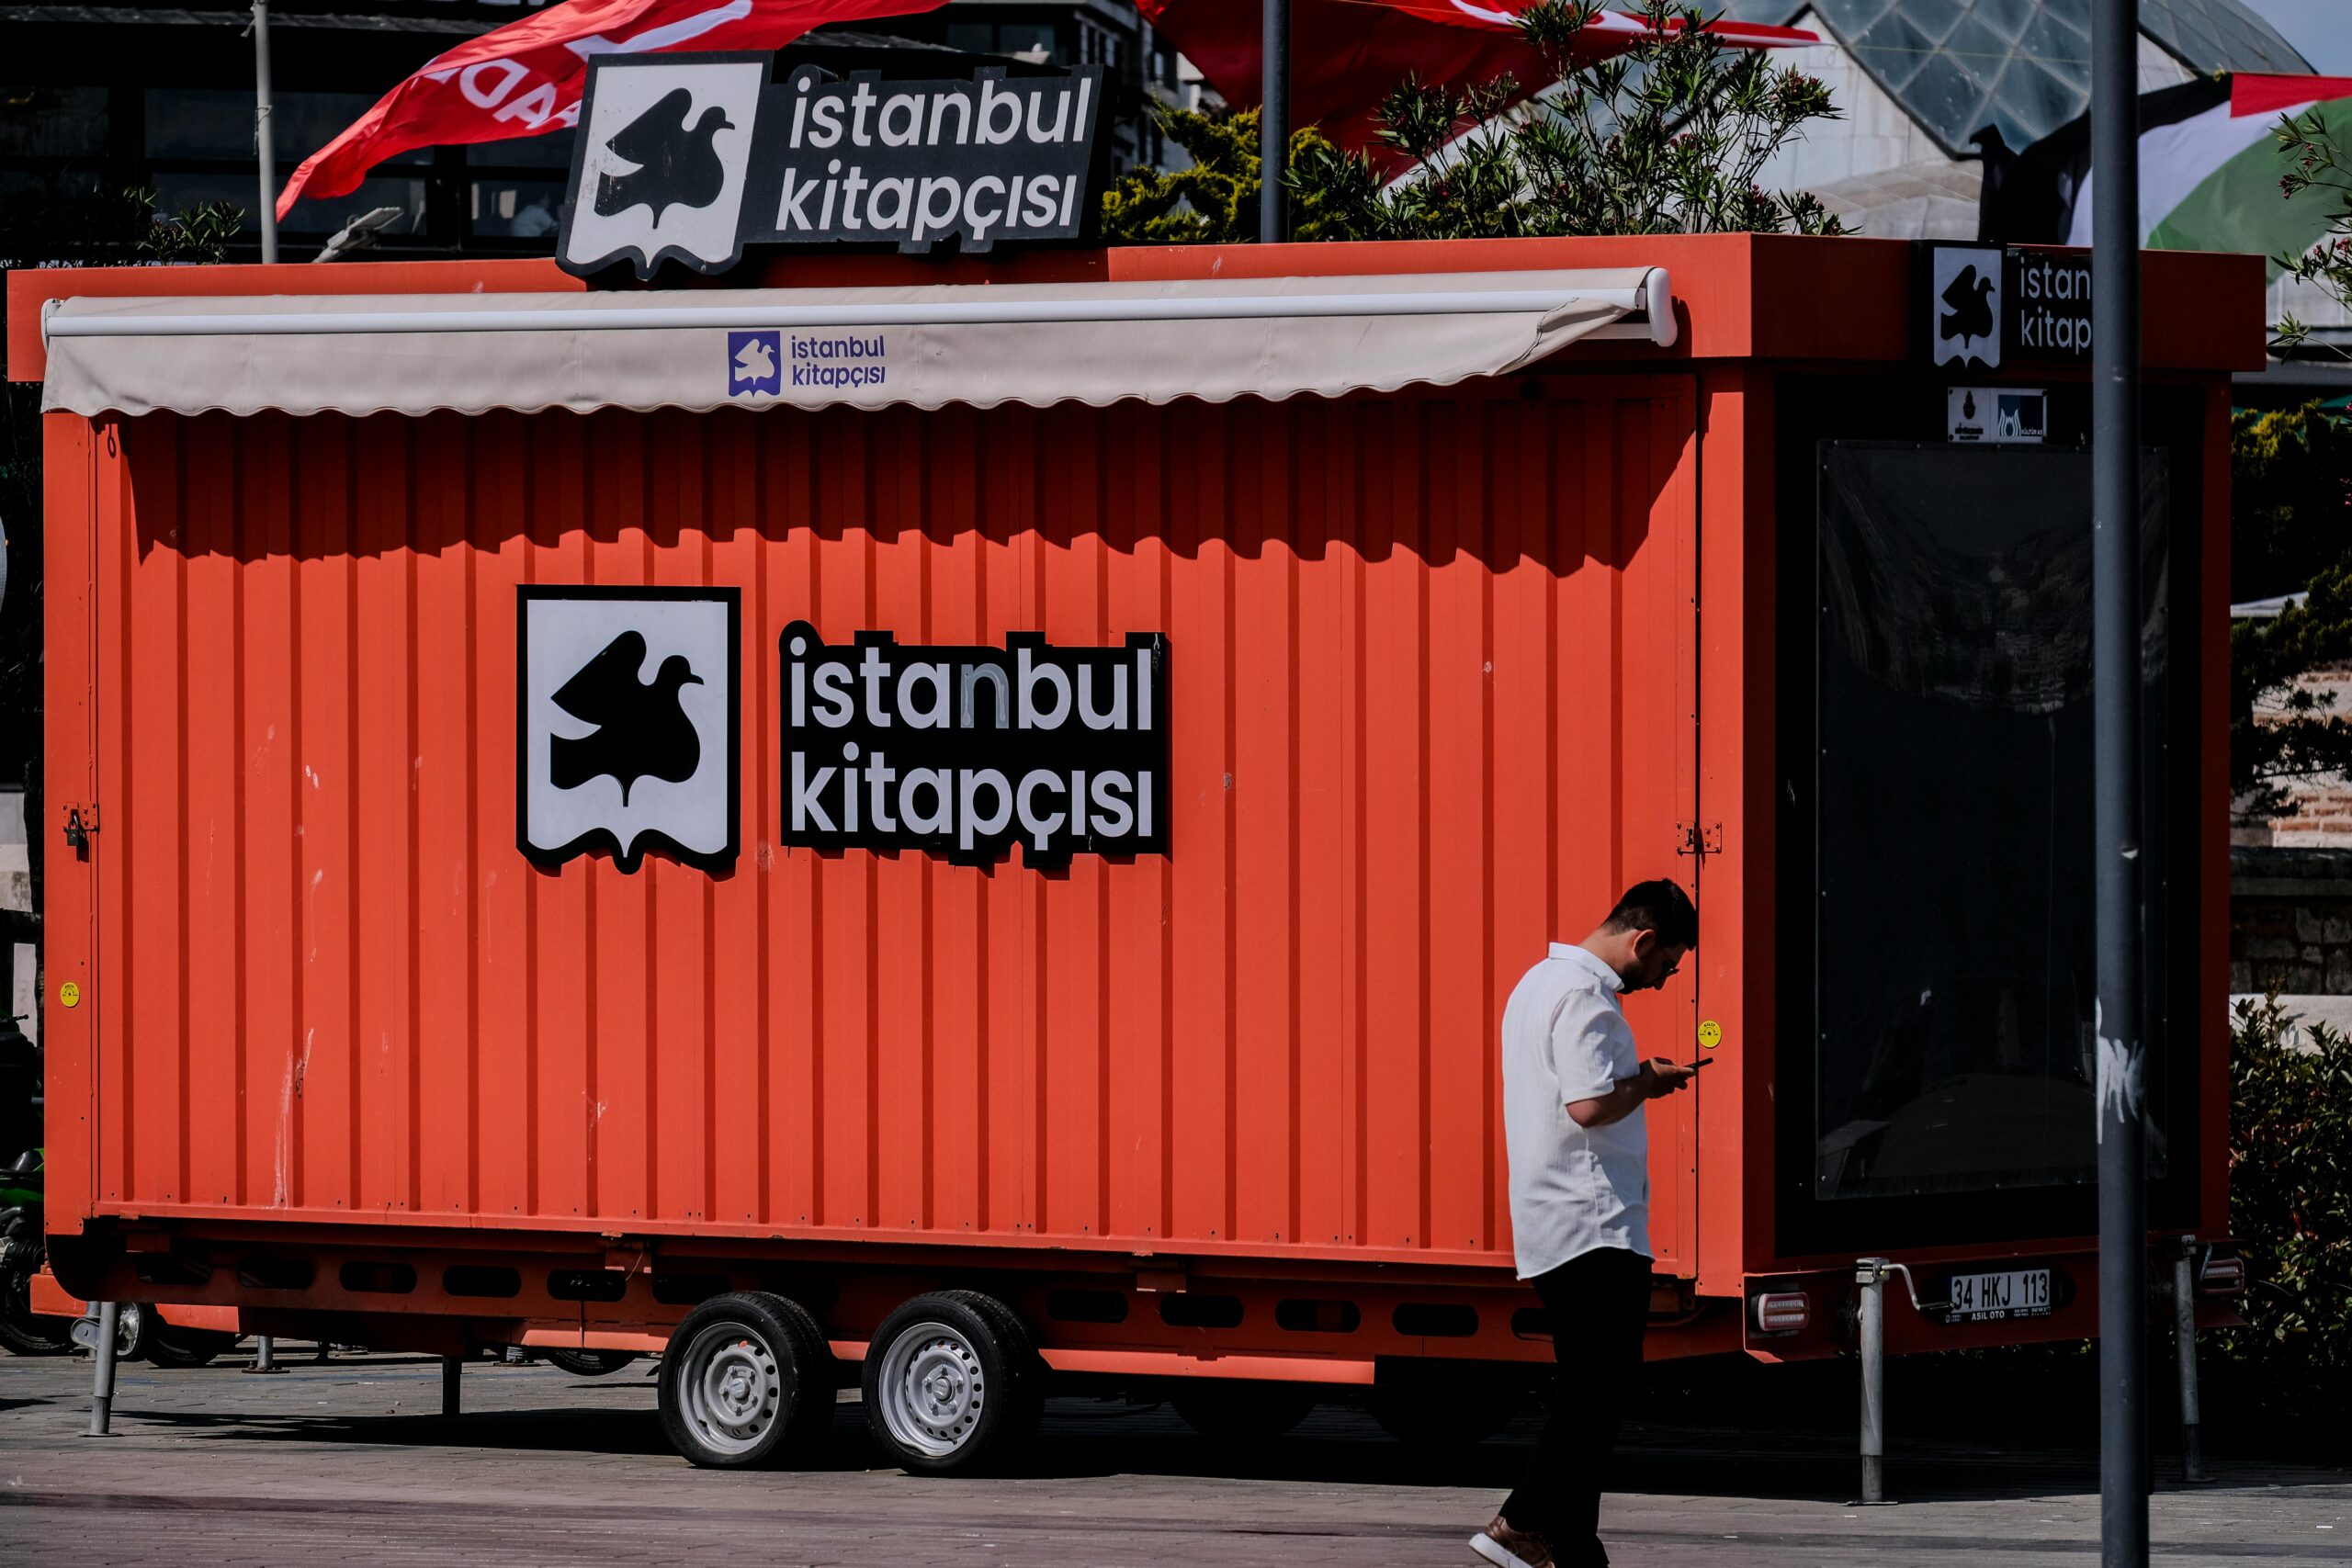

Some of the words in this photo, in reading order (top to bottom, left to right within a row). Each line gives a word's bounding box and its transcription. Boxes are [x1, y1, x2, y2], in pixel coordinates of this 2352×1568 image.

[789, 76, 1092, 149] istanbul
[775, 158, 1078, 242] kitapçısı
[2020, 256, 2091, 299] istan
[791, 335, 886, 359] istanbul
[2021, 305, 2092, 355] kitap
[792, 362, 886, 389] kitapçısı
[789, 636, 1152, 731] istanbul
[791, 740, 1152, 851] kitapçısı
[1953, 1279, 1973, 1311] 34
[1981, 1274, 2011, 1308] HKJ
[2023, 1272, 2048, 1304] 113
[1989, 1310, 2005, 1320] OTO
